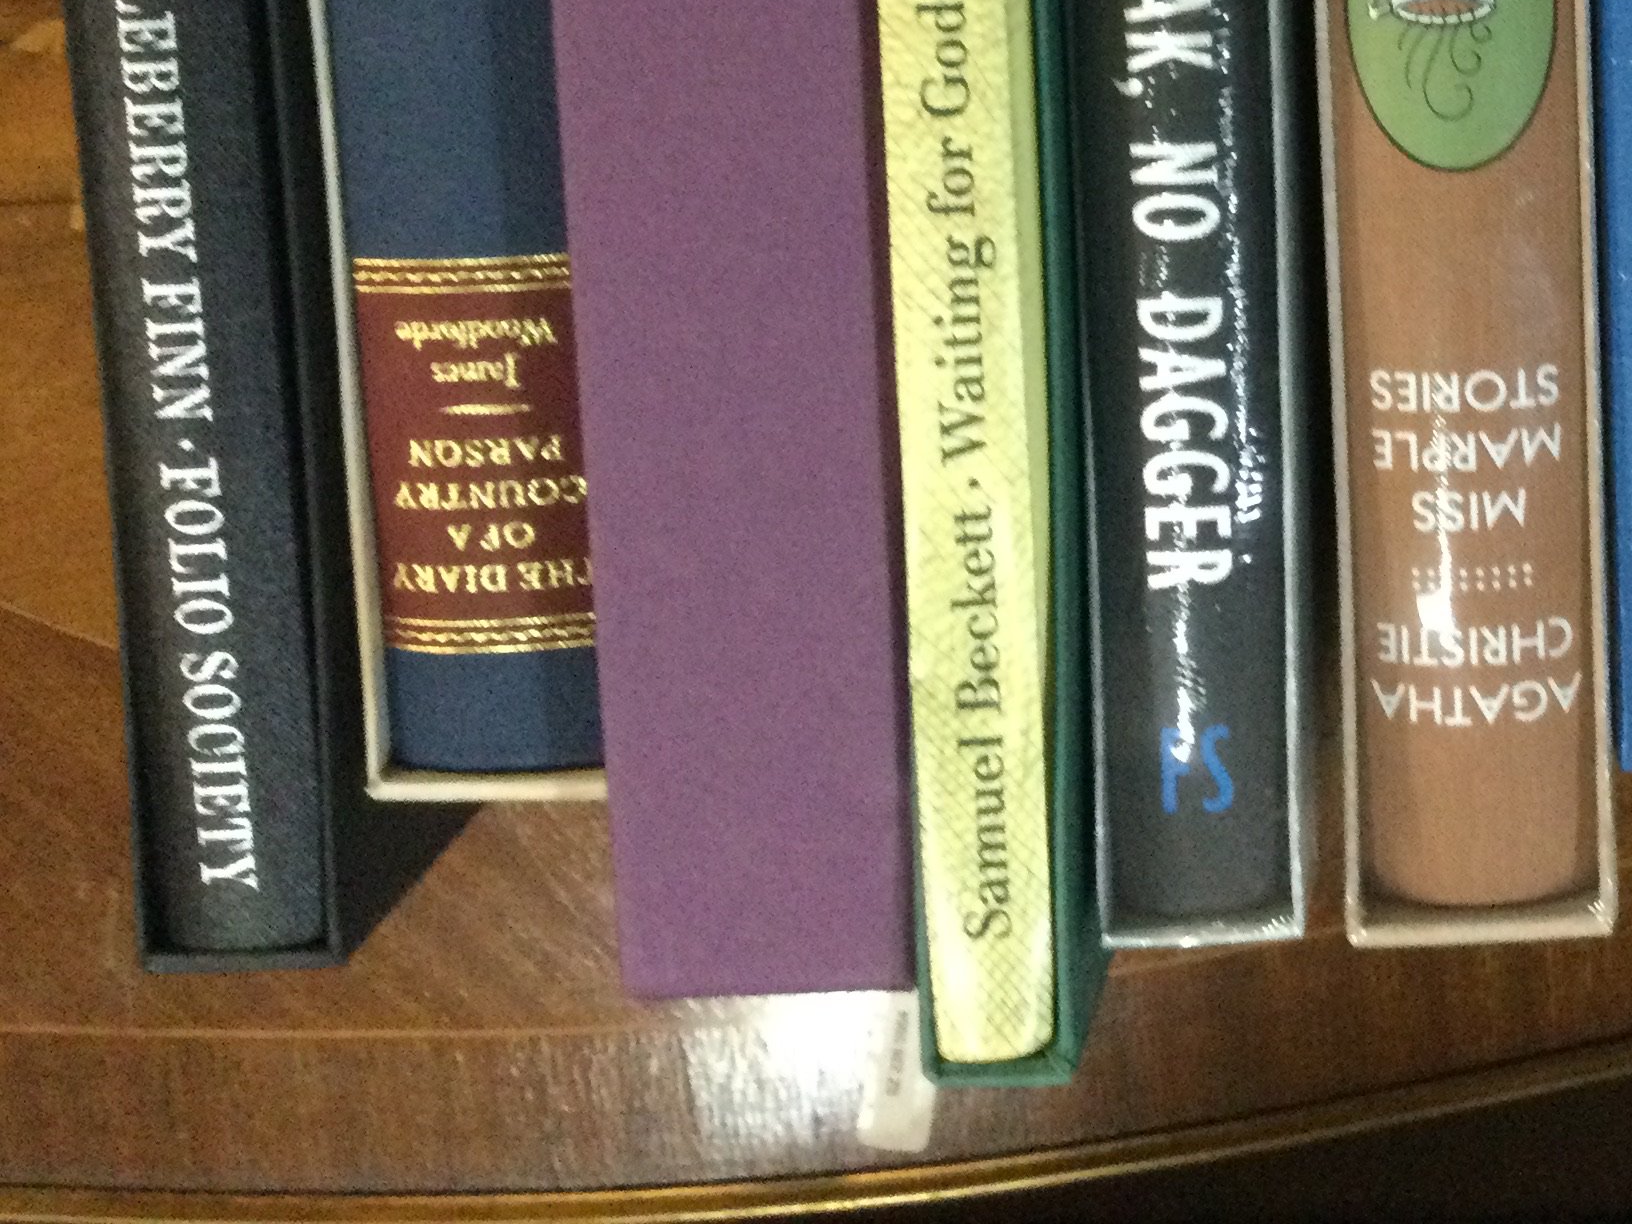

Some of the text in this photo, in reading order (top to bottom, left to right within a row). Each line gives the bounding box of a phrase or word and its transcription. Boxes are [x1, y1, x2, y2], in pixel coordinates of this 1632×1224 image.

[926, 136, 977, 217] for
[1129, 142, 1222, 242] NO
[139, 276, 213, 422] FINN
[394, 317, 558, 350] Woodforde
[936, 234, 996, 467] Waiting
[430, 352, 522, 389] James
[1369, 363, 1559, 413] STORIES
[408, 434, 565, 468] PARSON
[1136, 295, 1235, 590] DAGGER
[1370, 422, 1562, 473] MARPLE
[395, 475, 588, 511] COUNTRY
[1411, 487, 1526, 533] MISS
[159, 457, 234, 637] FOLIO
[446, 521, 535, 553] OF A
[393, 557, 593, 594] THE DIARY
[953, 495, 1002, 717] Beckett
[1377, 617, 1573, 668] CHRISTIE
[1370, 672, 1582, 727] AGATHA
[179, 651, 260, 892] SOCIETY
[956, 731, 1013, 941] Samuel
